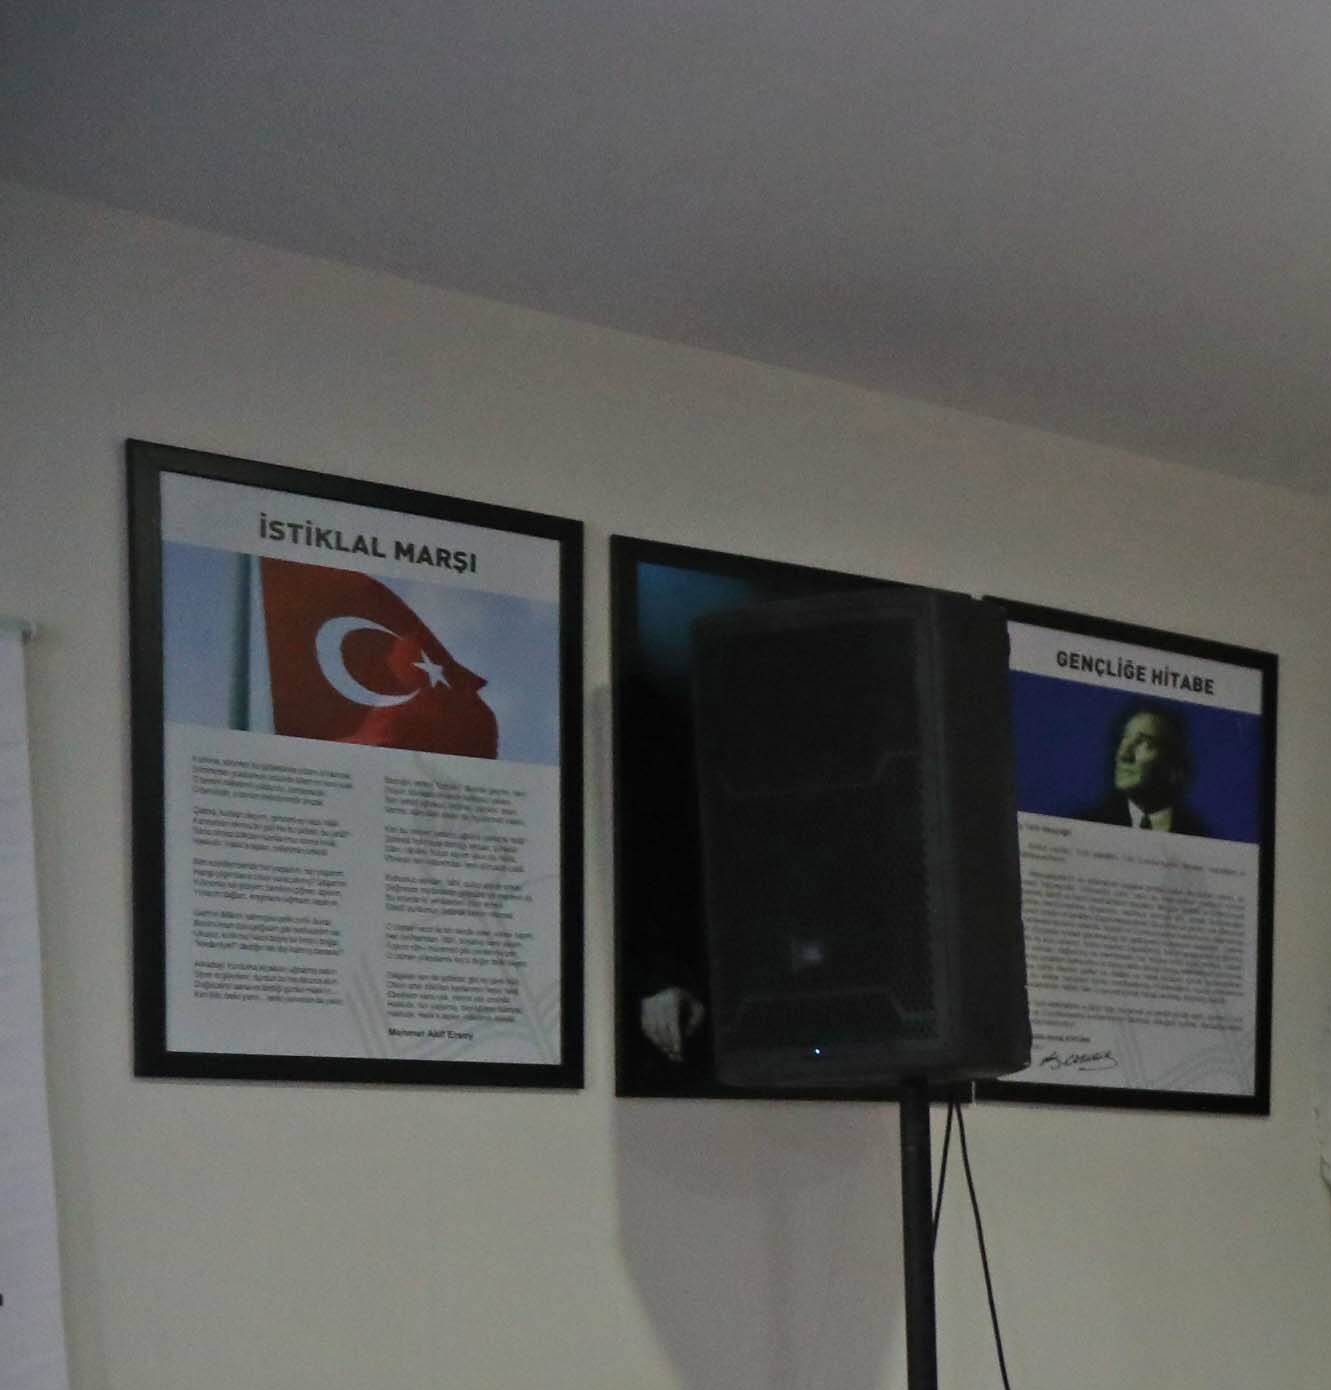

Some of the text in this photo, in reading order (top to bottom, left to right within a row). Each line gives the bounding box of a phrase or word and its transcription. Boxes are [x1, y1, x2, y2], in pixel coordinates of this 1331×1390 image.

[259, 511, 477, 575] İSTİKLAL MARŞI
[1056, 649, 1215, 695] GENÇLİĞE HİTABE
